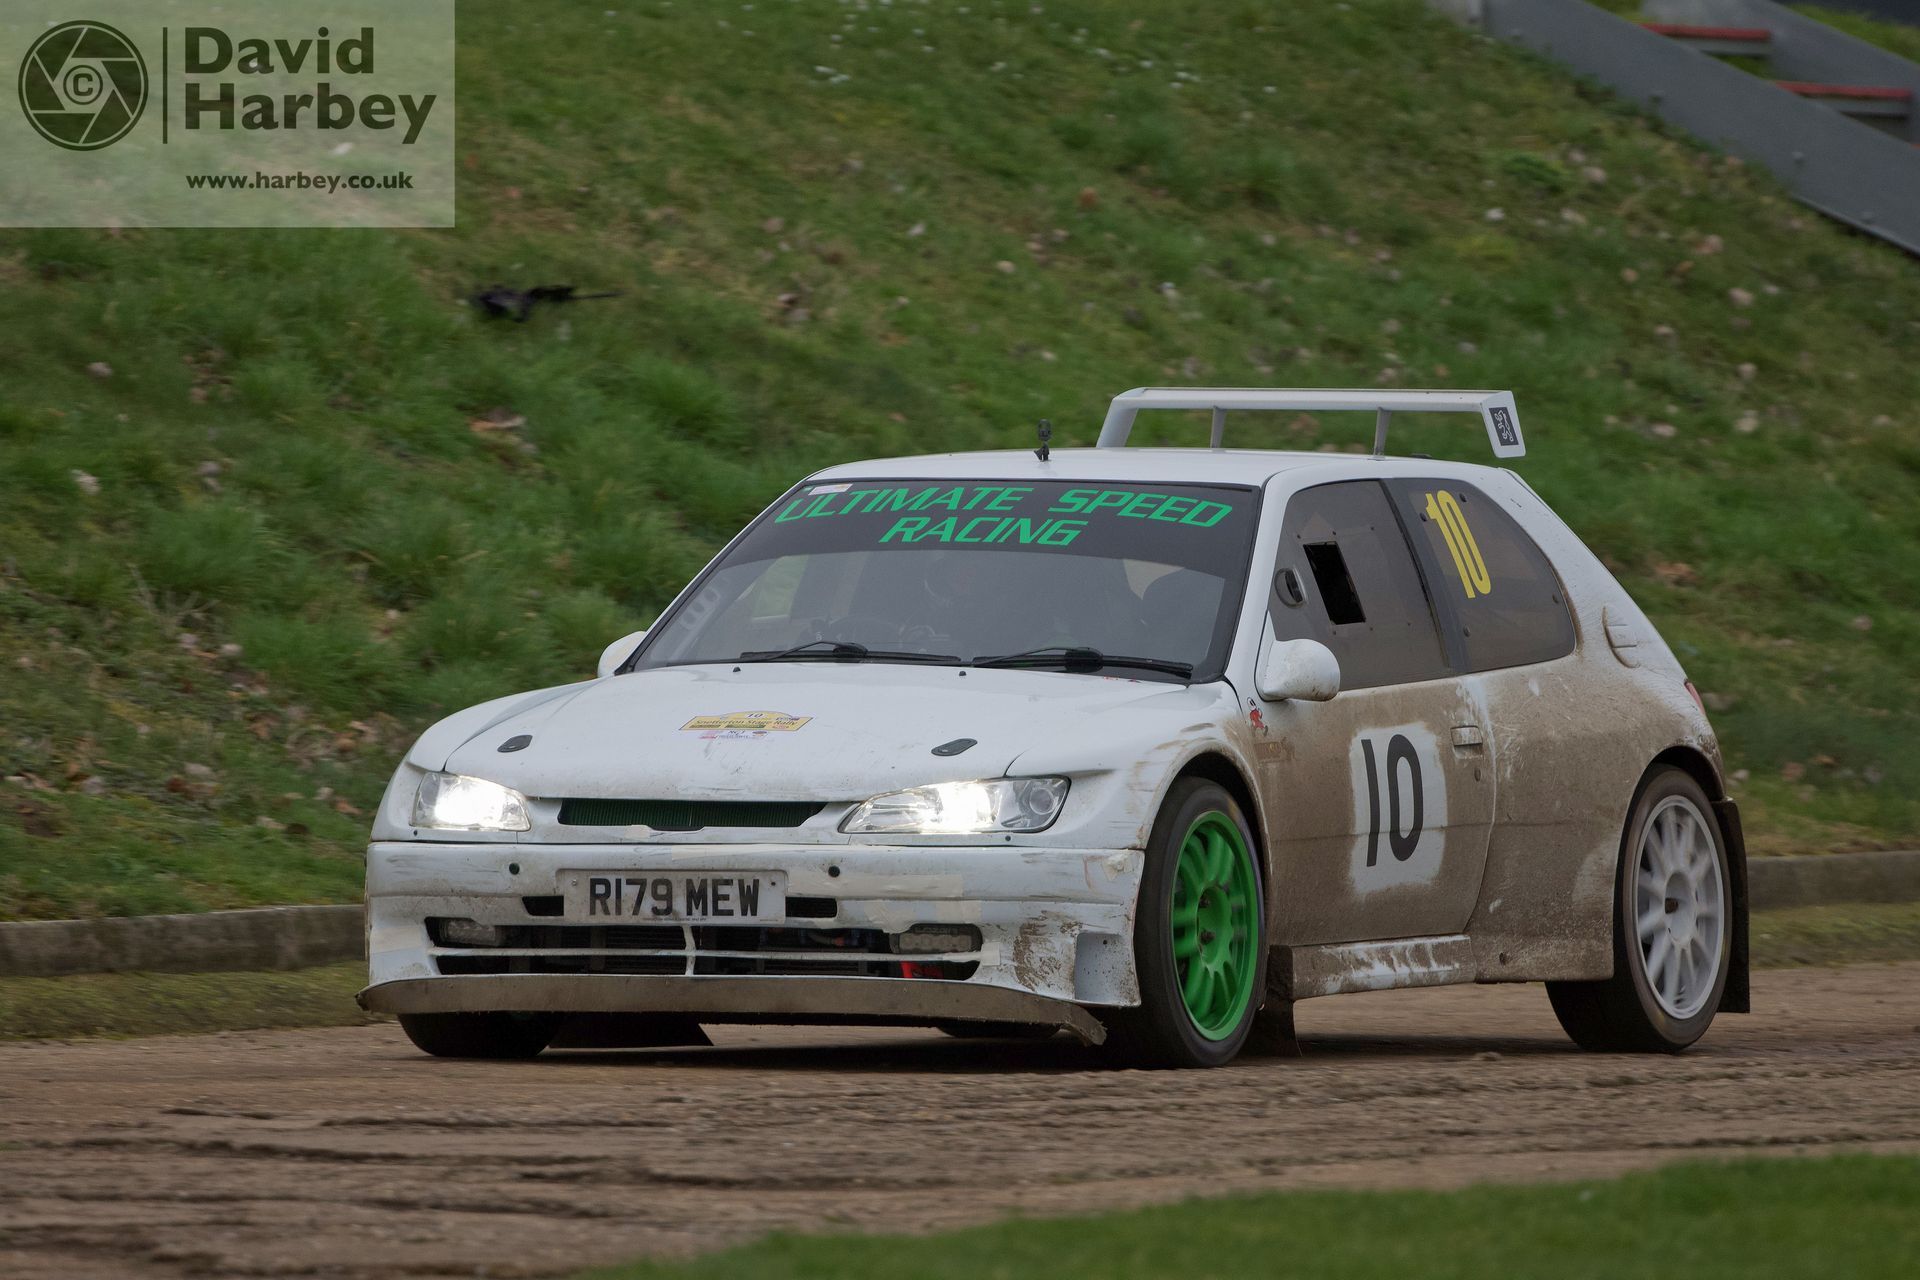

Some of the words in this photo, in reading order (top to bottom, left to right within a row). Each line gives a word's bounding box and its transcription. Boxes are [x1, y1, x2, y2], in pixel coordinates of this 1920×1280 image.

[774, 486, 1033, 524] ULTIMATE
[1048, 489, 1233, 528] SPEED
[878, 516, 1089, 546] RACING
[1425, 490, 1491, 598] 10
[1361, 734, 1424, 867] 10
[589, 877, 673, 917] R179
[685, 877, 760, 917] MEW
